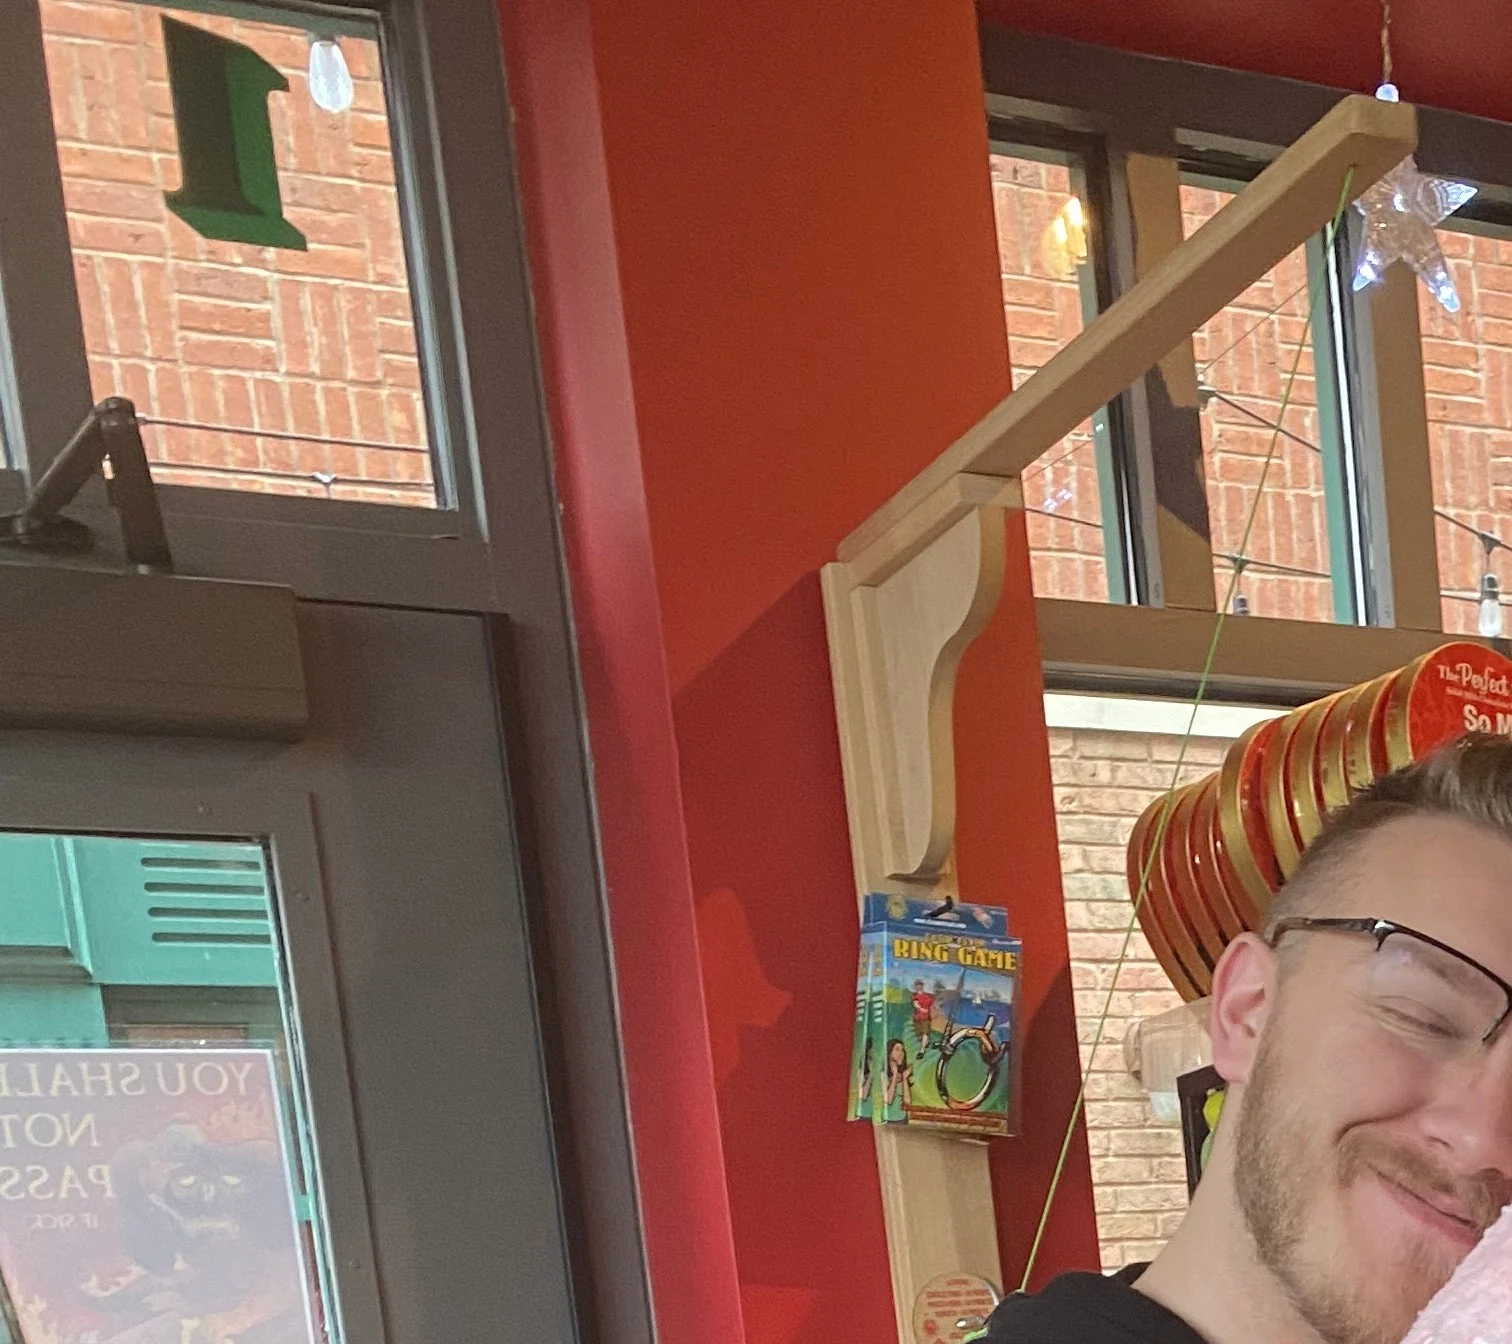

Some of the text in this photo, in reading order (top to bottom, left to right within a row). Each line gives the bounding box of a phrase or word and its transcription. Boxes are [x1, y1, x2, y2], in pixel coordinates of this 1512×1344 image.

[1457, 662, 1510, 698] Perfect
[893, 939, 950, 963] RING
[957, 945, 1017, 970] GAME
